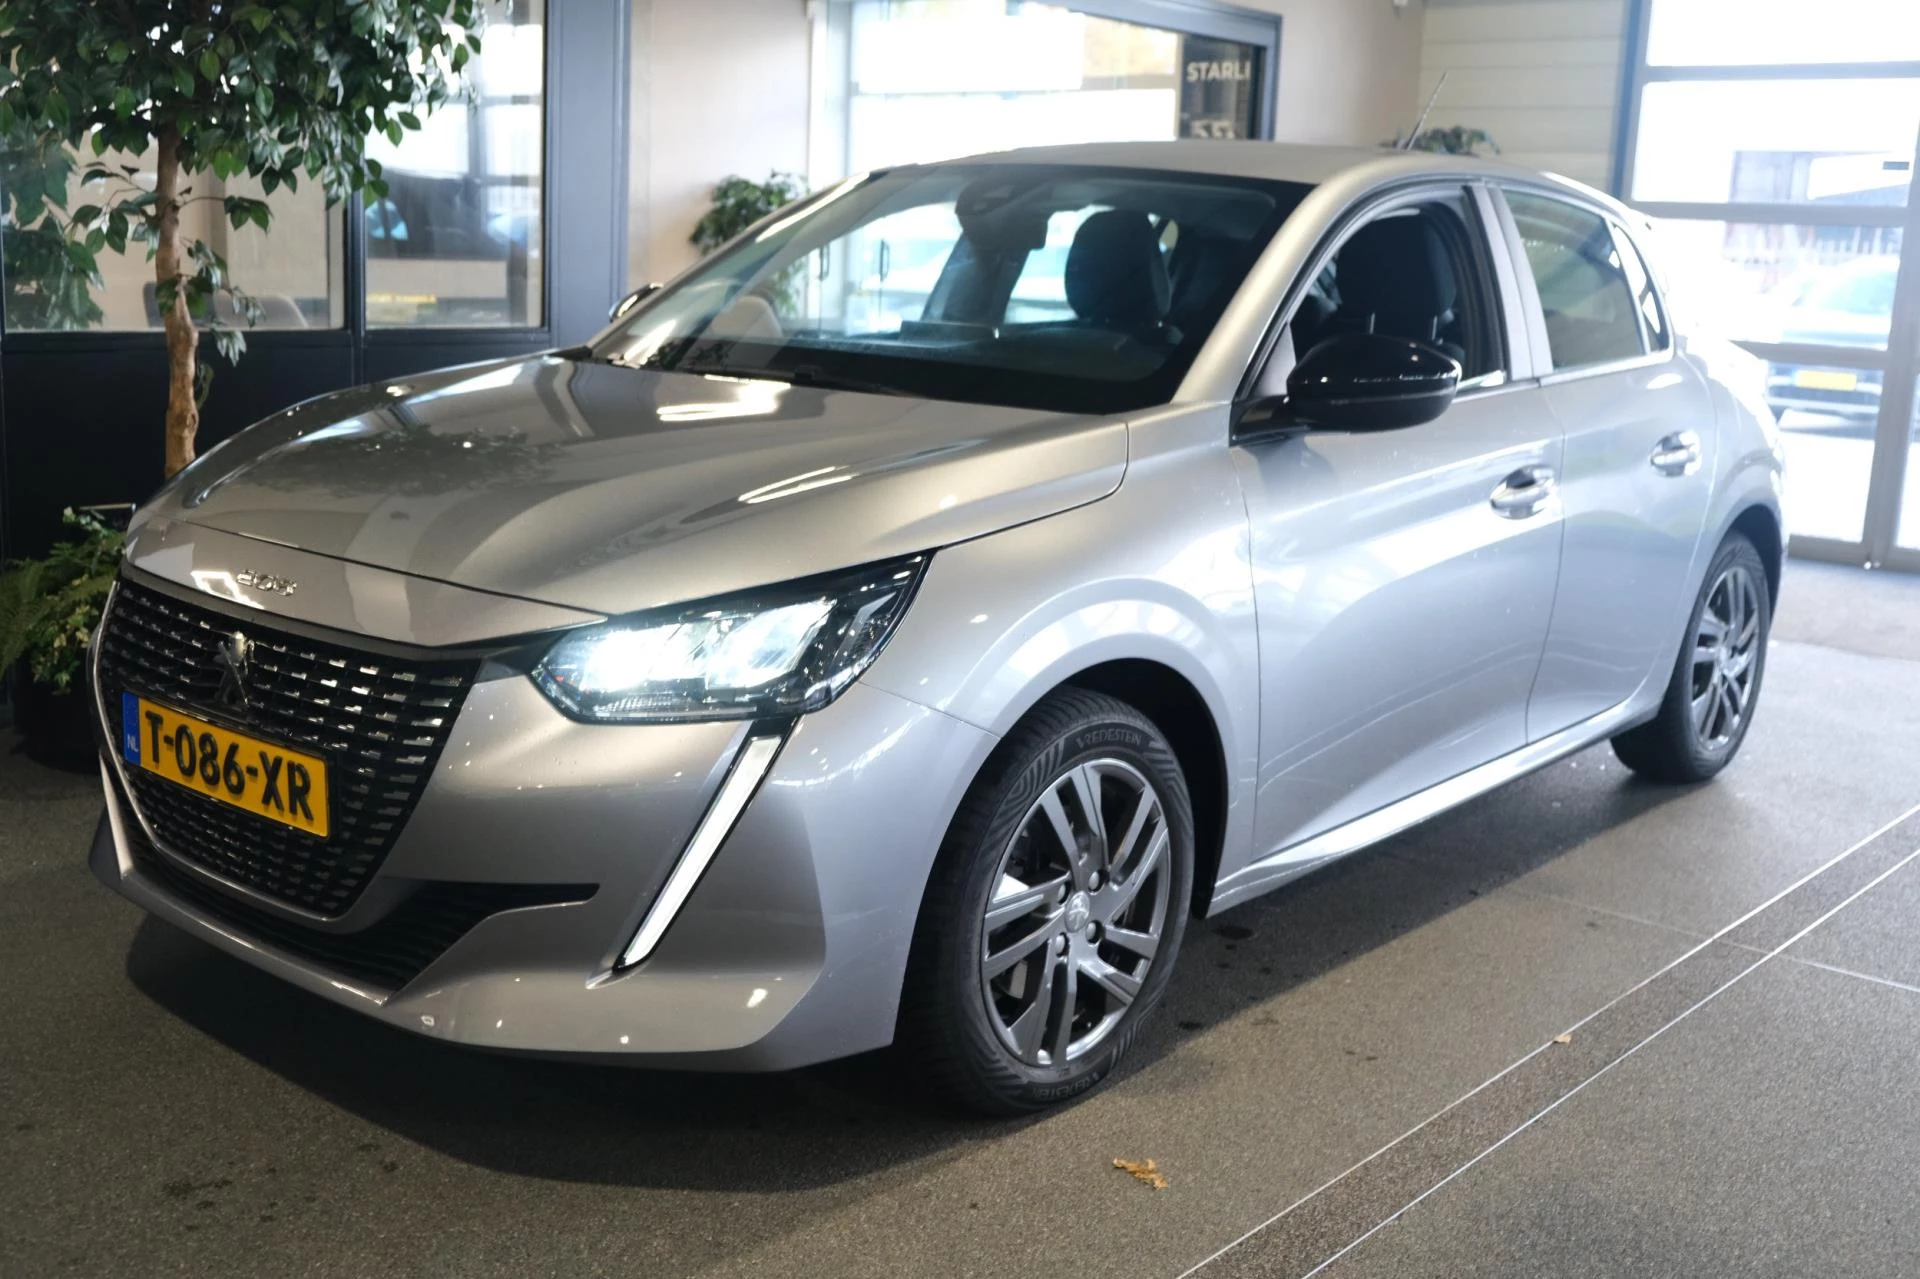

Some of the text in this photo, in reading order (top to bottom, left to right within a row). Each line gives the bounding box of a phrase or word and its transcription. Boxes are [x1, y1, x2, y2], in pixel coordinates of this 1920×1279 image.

[1186, 61, 1251, 82] STARLI
[126, 733, 139, 753] NL
[1075, 727, 1142, 749] VREDESTEIN
[145, 710, 314, 821] T-086-XR
